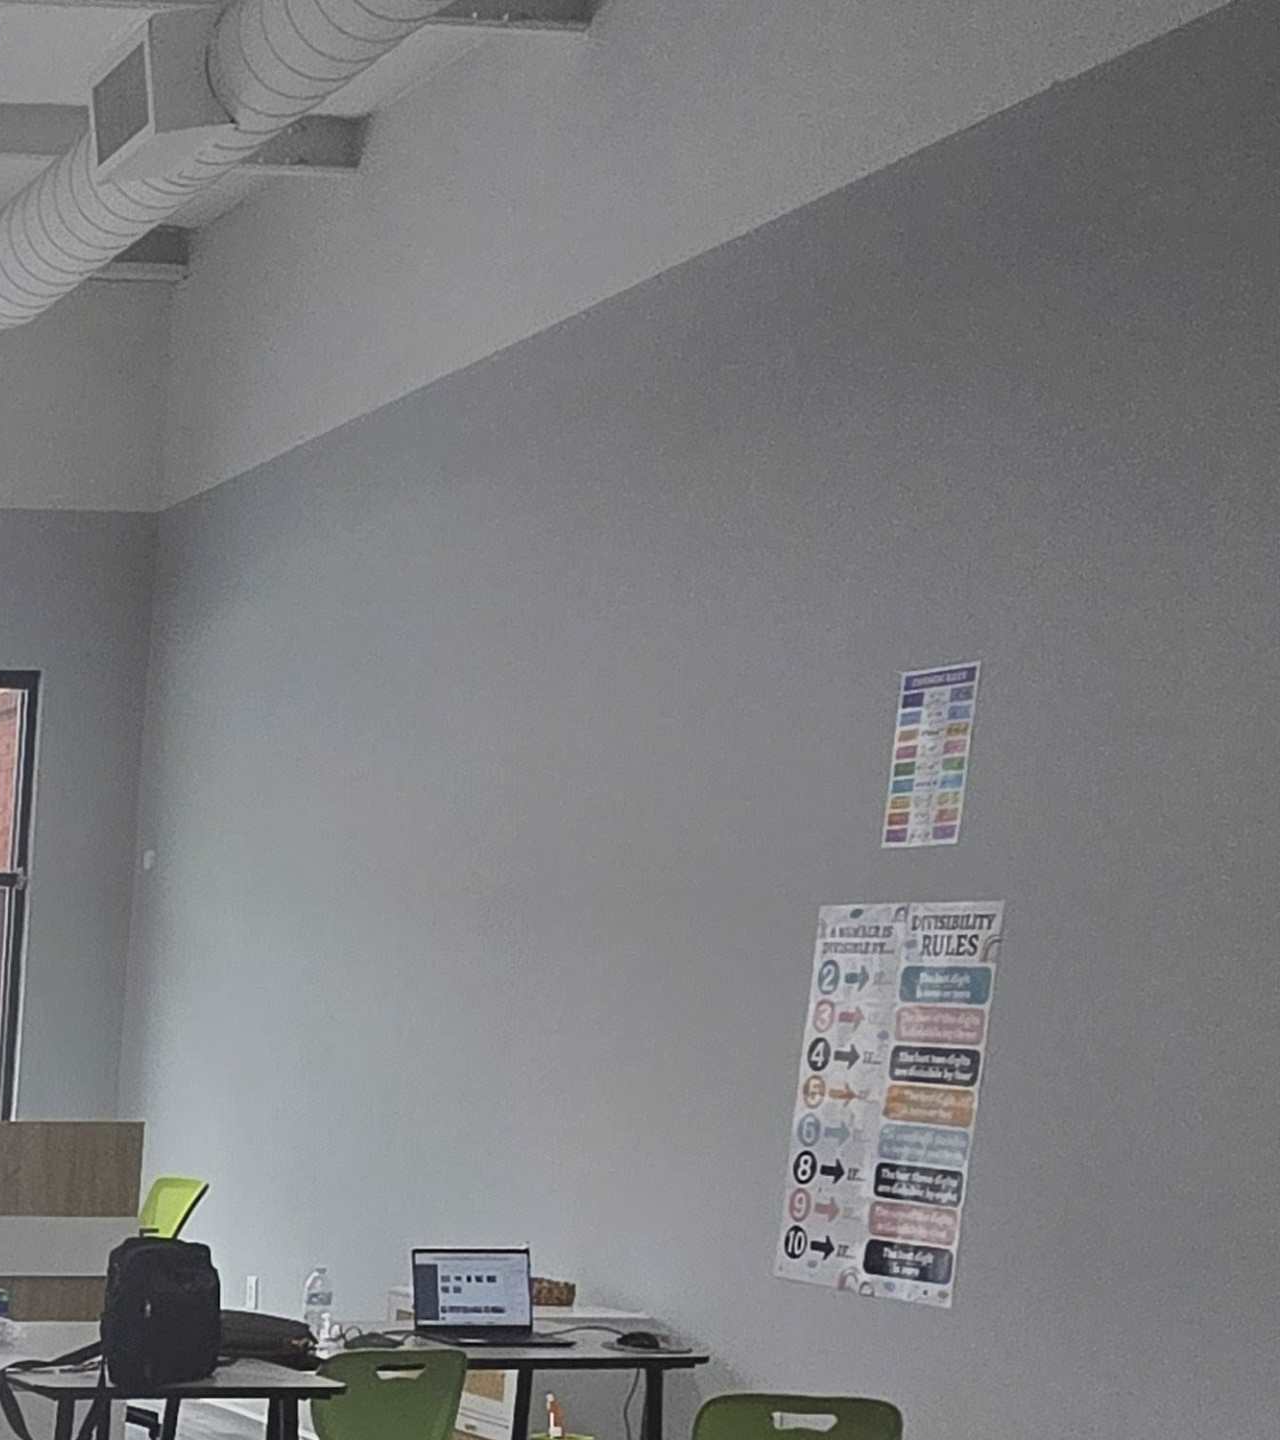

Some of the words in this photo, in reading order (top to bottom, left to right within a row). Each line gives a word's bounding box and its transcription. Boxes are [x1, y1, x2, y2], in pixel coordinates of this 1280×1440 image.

[920, 934, 980, 957] RULES
[811, 1041, 825, 1067] 4
[798, 1152, 812, 1181] 8
[793, 1191, 806, 1219] 9
[787, 1229, 804, 1257] 10
